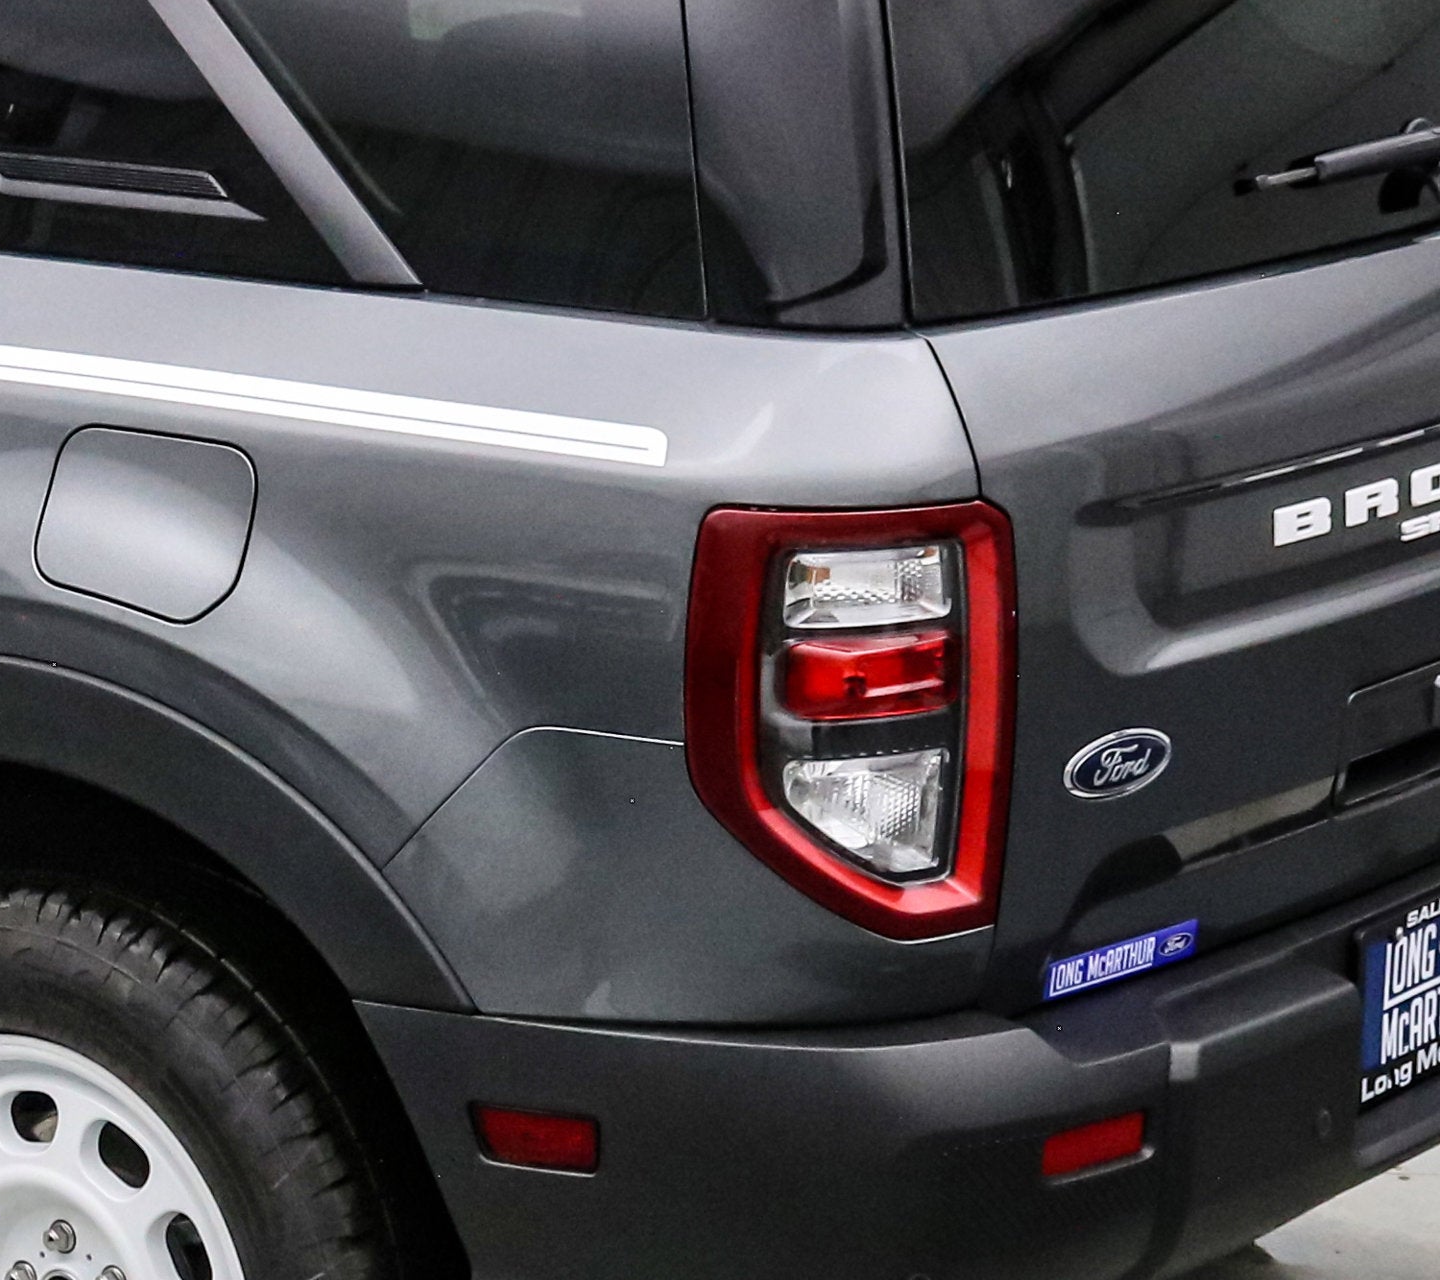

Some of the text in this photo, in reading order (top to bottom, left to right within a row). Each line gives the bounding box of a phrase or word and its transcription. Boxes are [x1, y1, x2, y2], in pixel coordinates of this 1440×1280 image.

[1093, 743, 1152, 787] Ford
[1048, 936, 1157, 998] LONG McARTHUR
[1382, 922, 1439, 1012] LONG
